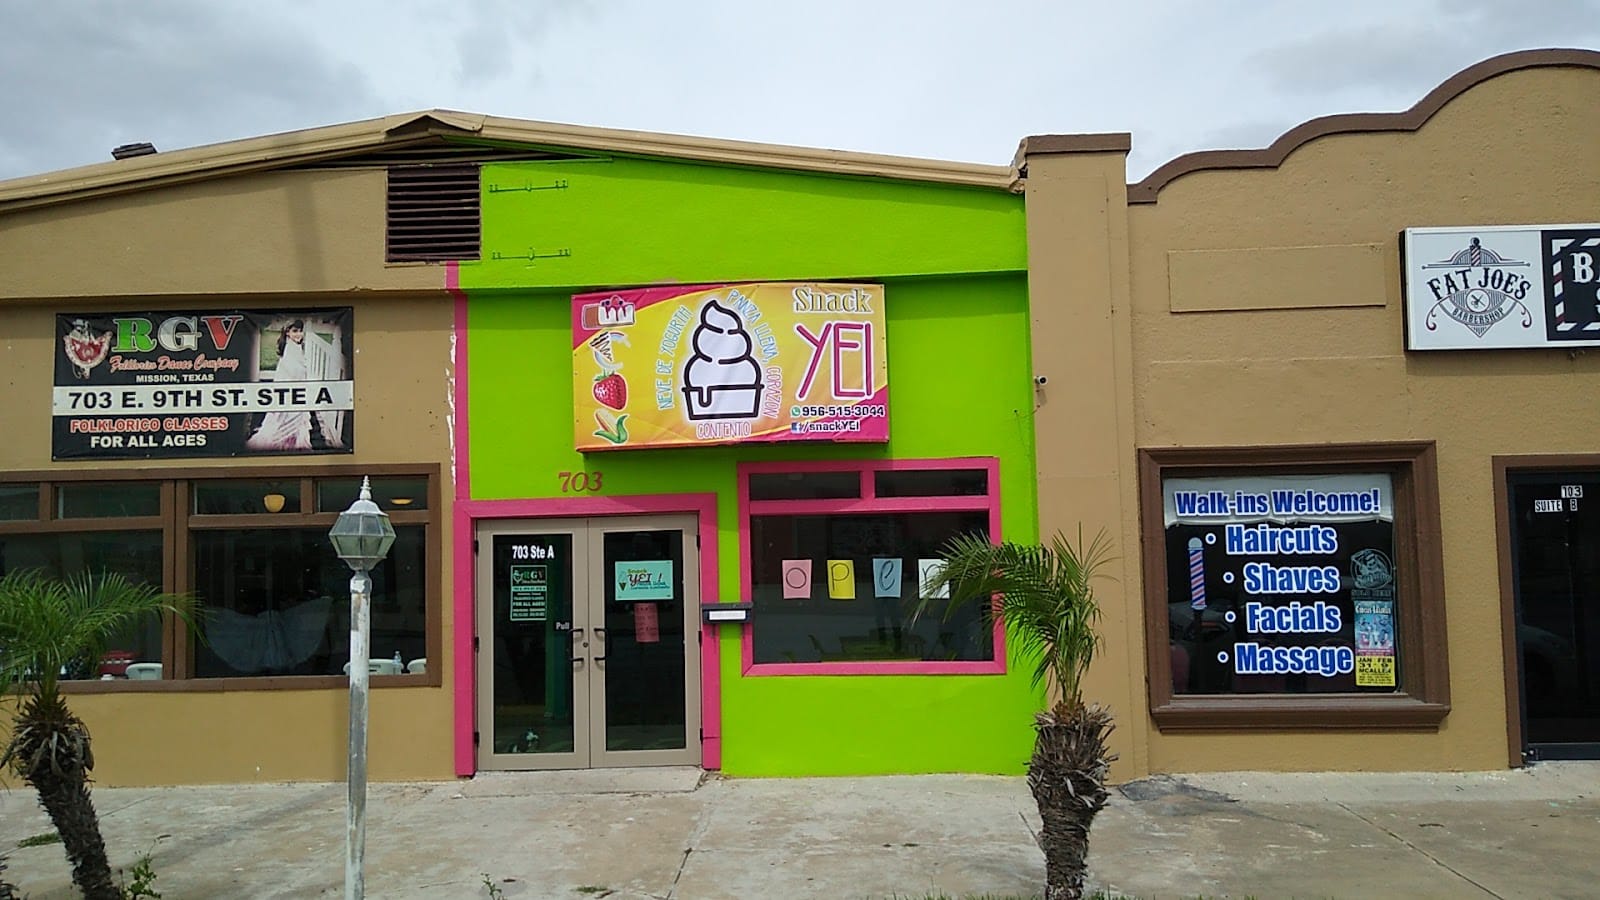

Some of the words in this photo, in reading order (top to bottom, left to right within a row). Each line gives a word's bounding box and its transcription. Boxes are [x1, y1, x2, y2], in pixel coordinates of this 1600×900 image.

[1569, 252, 1600, 284] B
[1426, 268, 1472, 301] FAT
[1478, 267, 1532, 300] JOE'S
[793, 288, 873, 314] Snack
[1452, 307, 1504, 324] BARBERSHOP
[111, 315, 244, 353] RGV
[157, 357, 193, 371] Dance
[194, 354, 239, 372] Company
[656, 359, 673, 375] DE
[795, 321, 874, 400] YEI
[136, 374, 180, 383] MISSION,
[182, 373, 214, 382] TEXAS
[68, 392, 113, 409] 703
[121, 391, 143, 408] E.
[153, 390, 201, 408] 9TH
[211, 389, 248, 407] ST.
[257, 388, 307, 405] STE
[315, 387, 333, 404] A
[657, 379, 673, 411] NEVE
[764, 366, 782, 419] CORAZON
[802, 406, 885, 417] 956-515-3044
[70, 418, 160, 433] FOLKLORICO
[163, 417, 229, 432] CLASSES
[697, 421, 751, 439] CONTENTO
[90, 436, 123, 449] FOR
[127, 435, 158, 448] ALL
[162, 434, 207, 447] AGES
[558, 471, 603, 493] 703
[1174, 490, 1270, 517] Walk-ins
[1271, 488, 1381, 516] Welcome!
[1535, 501, 1562, 511] SUITE
[1225, 524, 1338, 555] Haircuts
[512, 545, 528, 559] 703
[530, 545, 545, 559] Ste
[547, 545, 554, 559] A
[1243, 562, 1341, 594] Shaves
[556, 622, 570, 631] Pull
[1245, 601, 1341, 634] Facials
[1233, 643, 1354, 677] Massage
